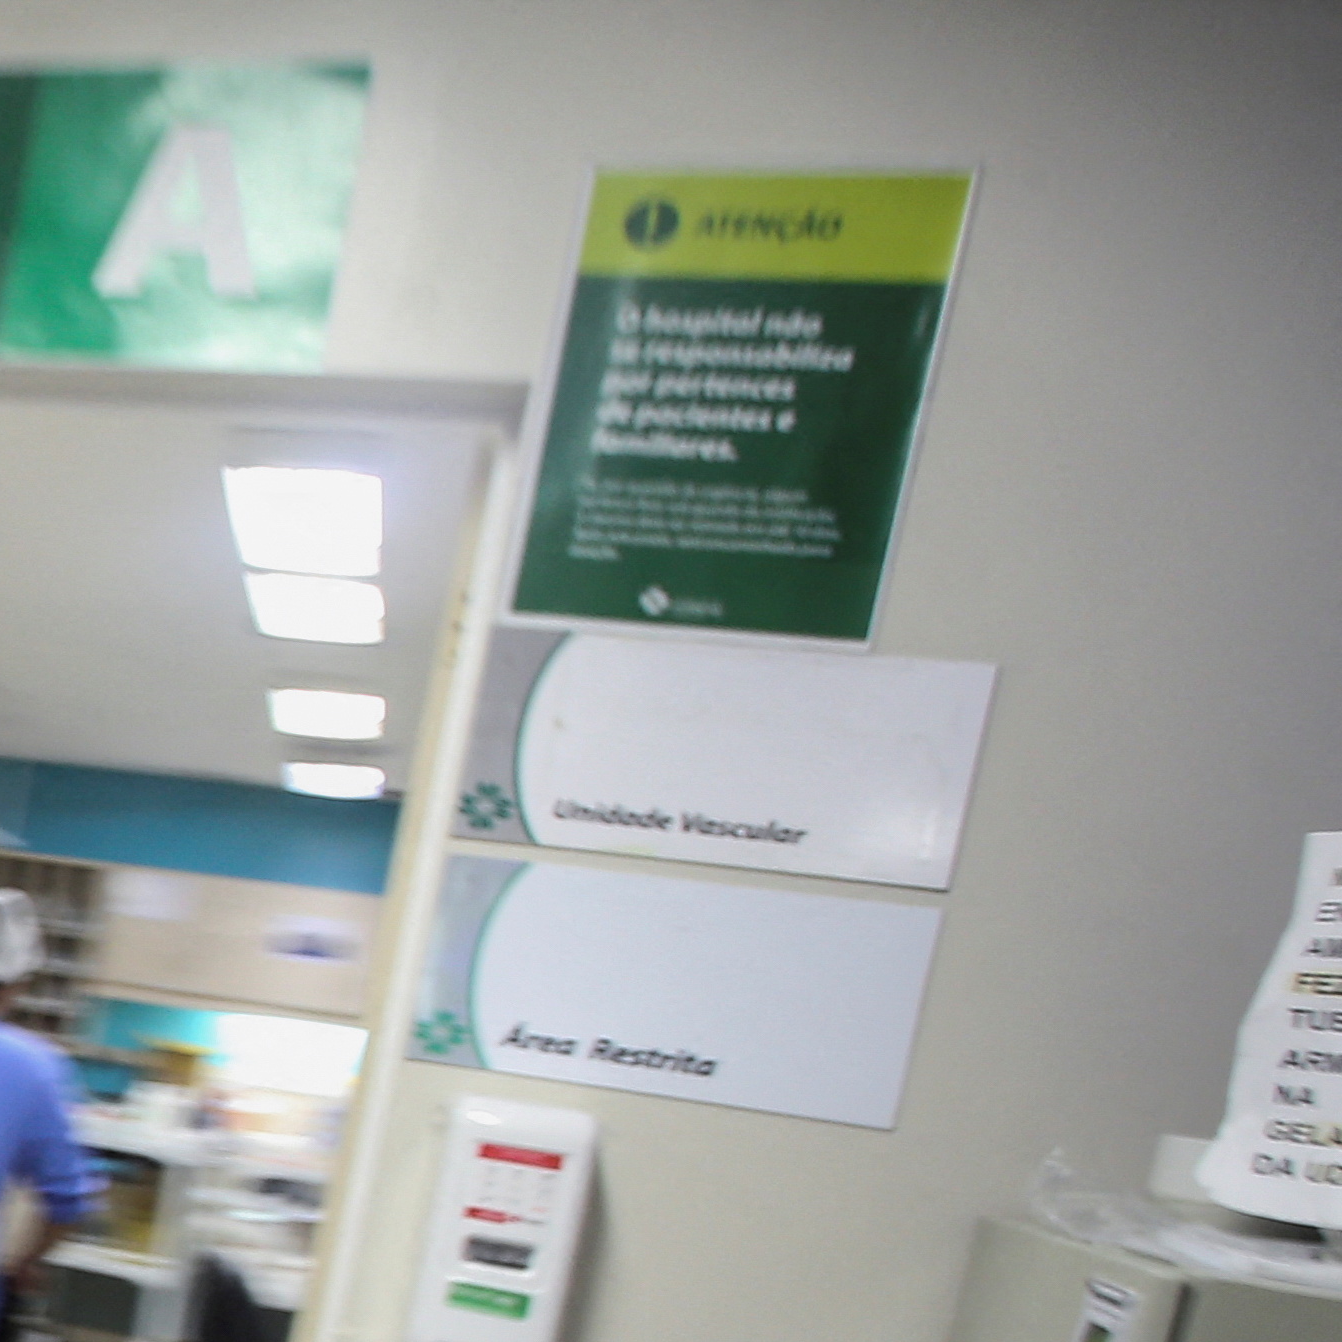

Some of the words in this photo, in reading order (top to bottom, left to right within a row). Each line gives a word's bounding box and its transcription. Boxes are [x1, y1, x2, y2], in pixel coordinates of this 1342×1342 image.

[91, 122, 257, 299] A
[698, 208, 844, 244] ATENÇÃO
[645, 304, 765, 341] hospital
[554, 799, 673, 831] Unidade
[680, 811, 807, 845] Vascular
[1315, 901, 1342, 922] E
[500, 1021, 578, 1056] Área
[588, 1037, 719, 1077] Restrita
